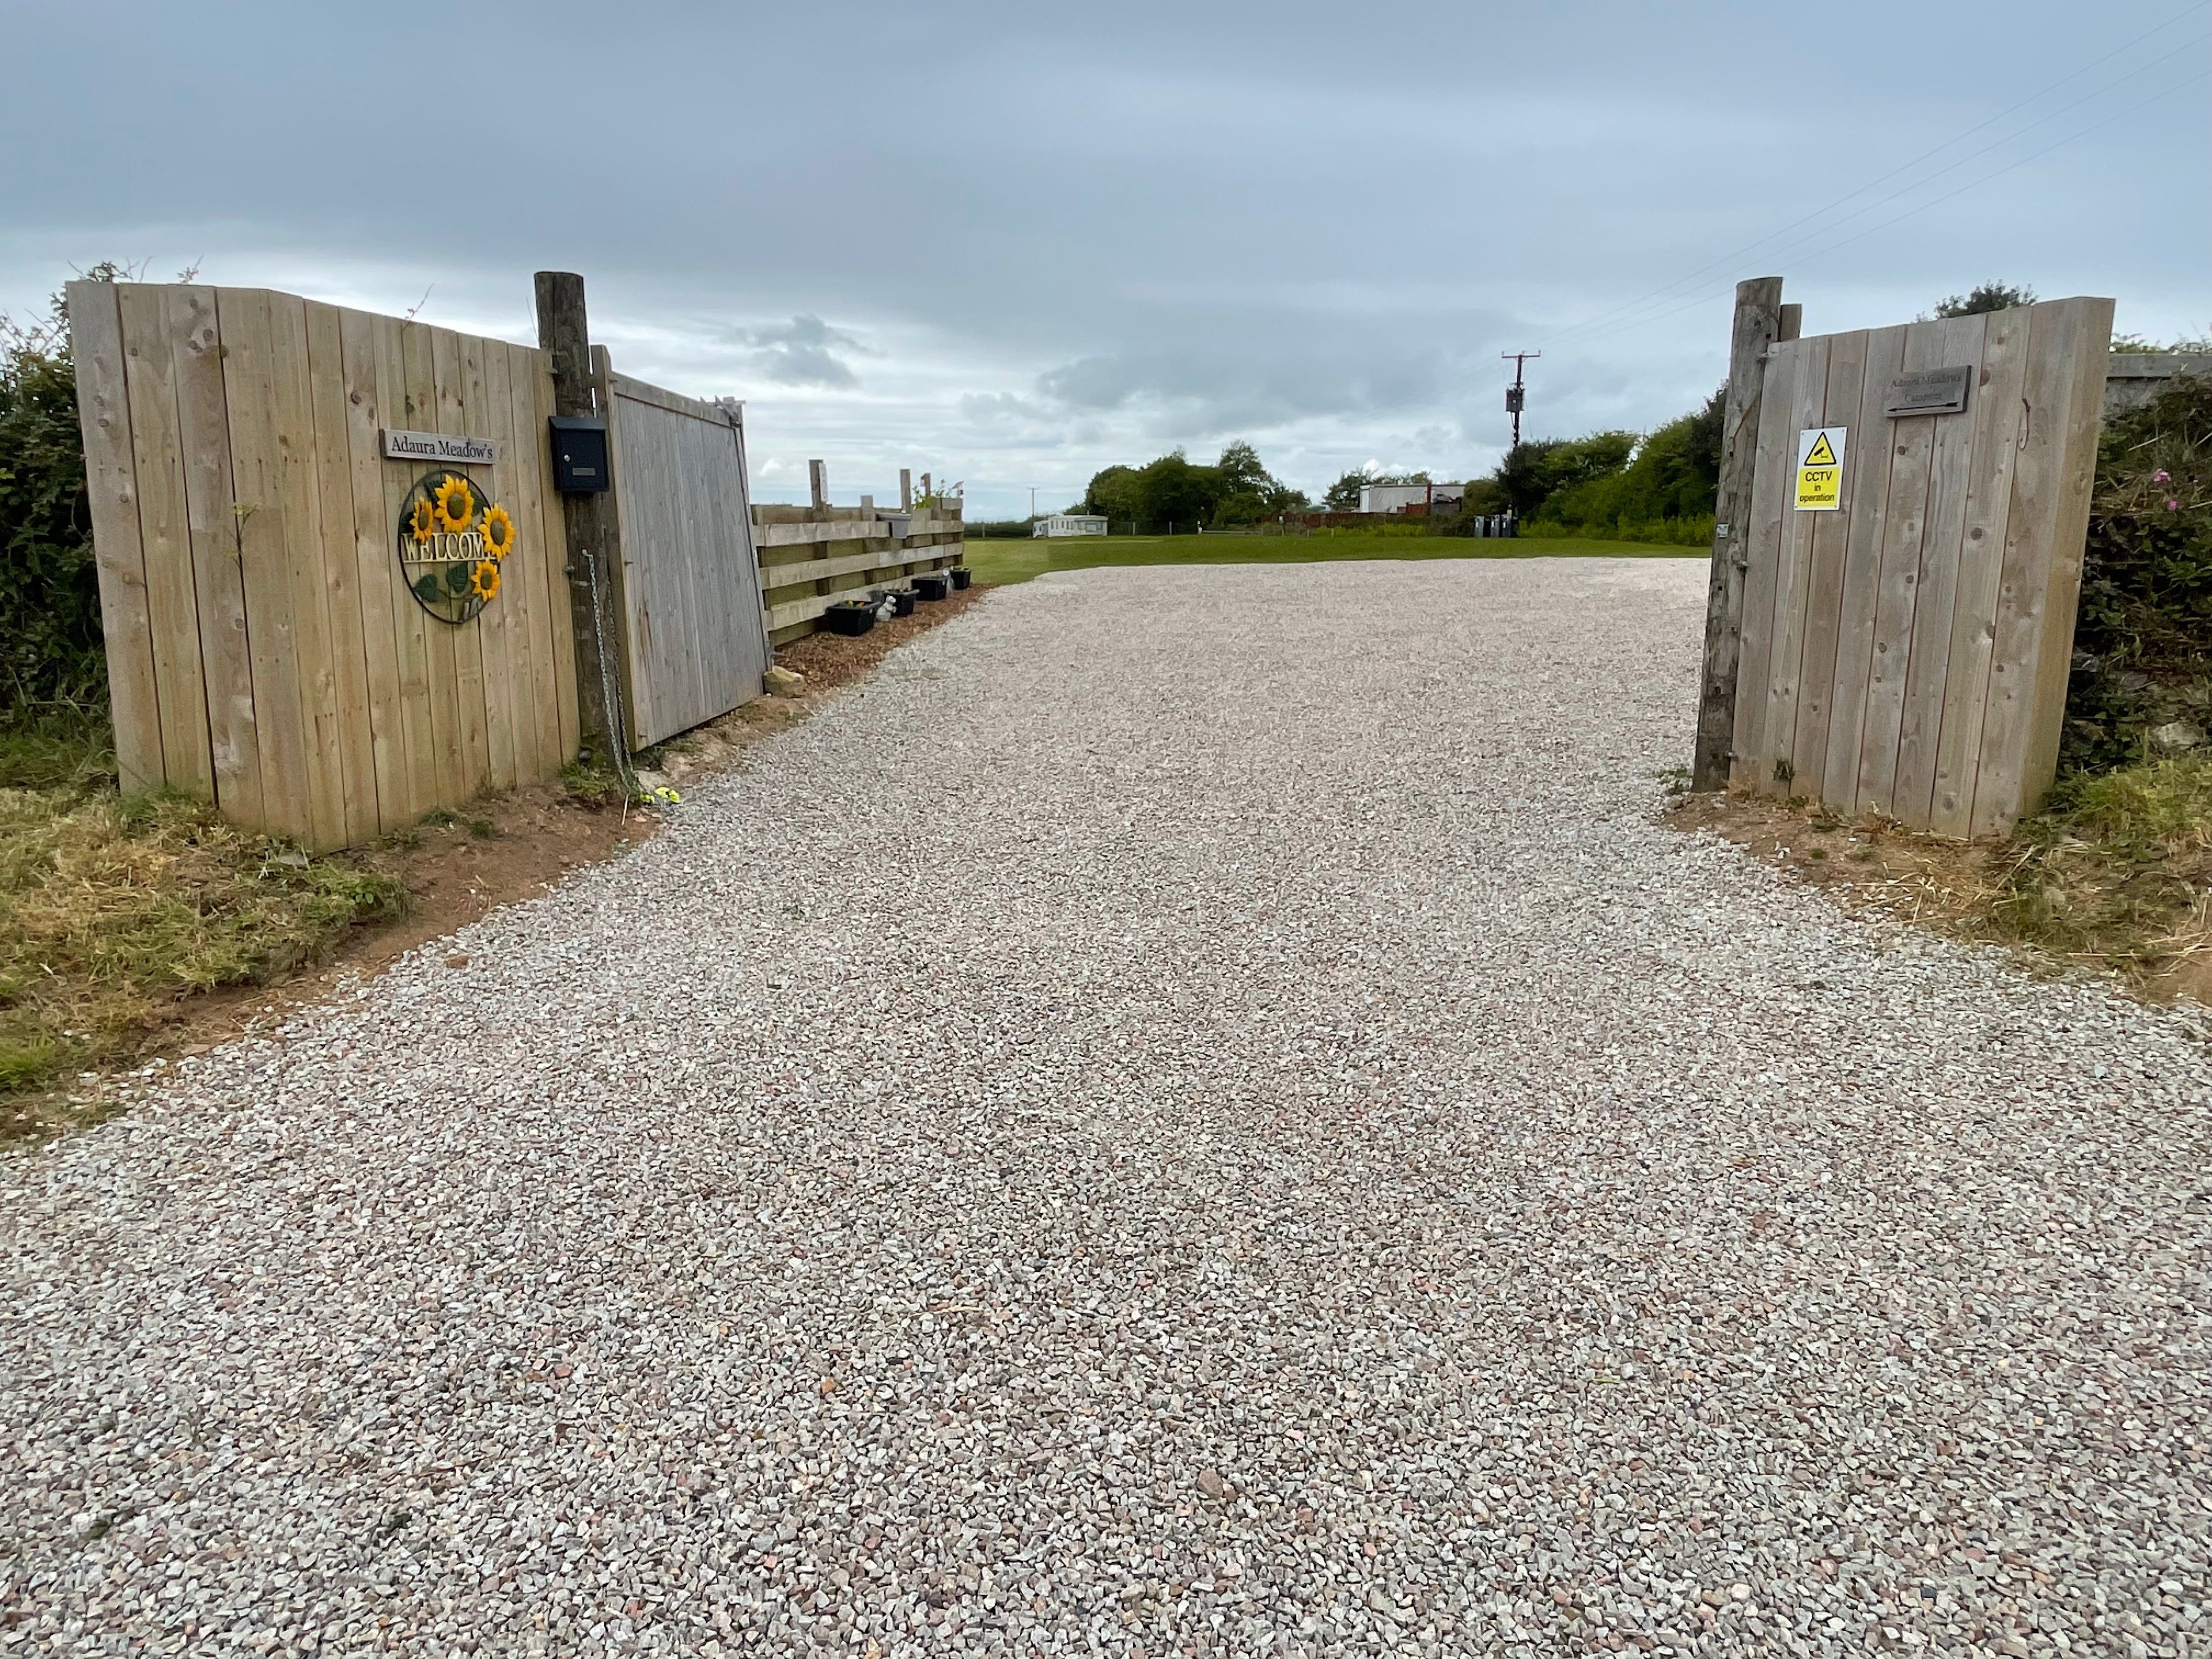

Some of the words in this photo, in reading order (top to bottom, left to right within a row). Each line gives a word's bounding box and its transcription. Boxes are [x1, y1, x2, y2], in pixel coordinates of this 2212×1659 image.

[392, 436, 436, 454] Adaura
[438, 440, 493, 459] Meadow's
[1805, 471, 1832, 482] CCTV
[1814, 483, 1821, 491] in
[1800, 493, 1834, 504] operation
[402, 532, 497, 562] WELCOM
